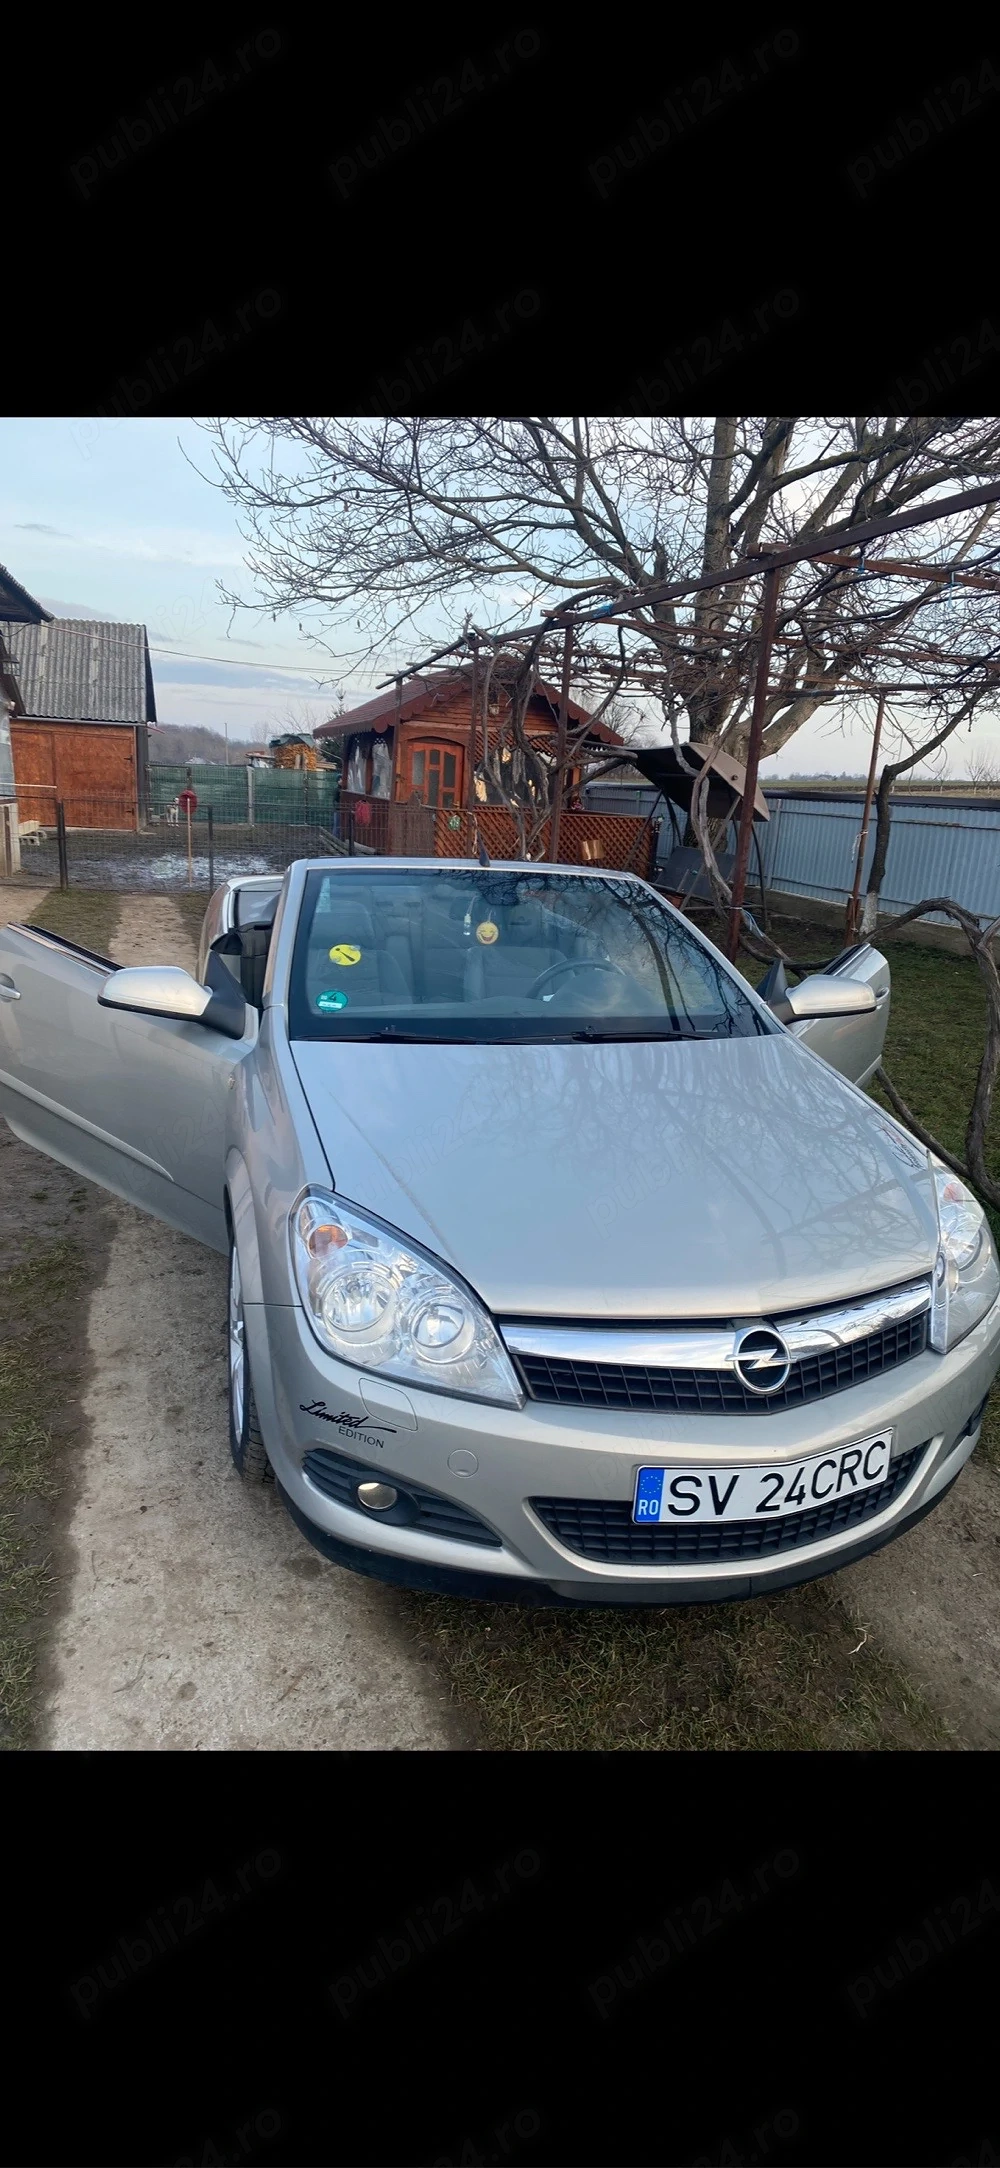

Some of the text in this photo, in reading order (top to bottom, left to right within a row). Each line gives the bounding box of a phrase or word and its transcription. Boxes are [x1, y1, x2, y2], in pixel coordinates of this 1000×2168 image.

[299, 1399, 397, 1434] Limited
[338, 1425, 385, 1449] EDITION
[667, 1474, 740, 1516] SV
[755, 1440, 887, 1514] 24CRC
[637, 1498, 659, 1516] RO
